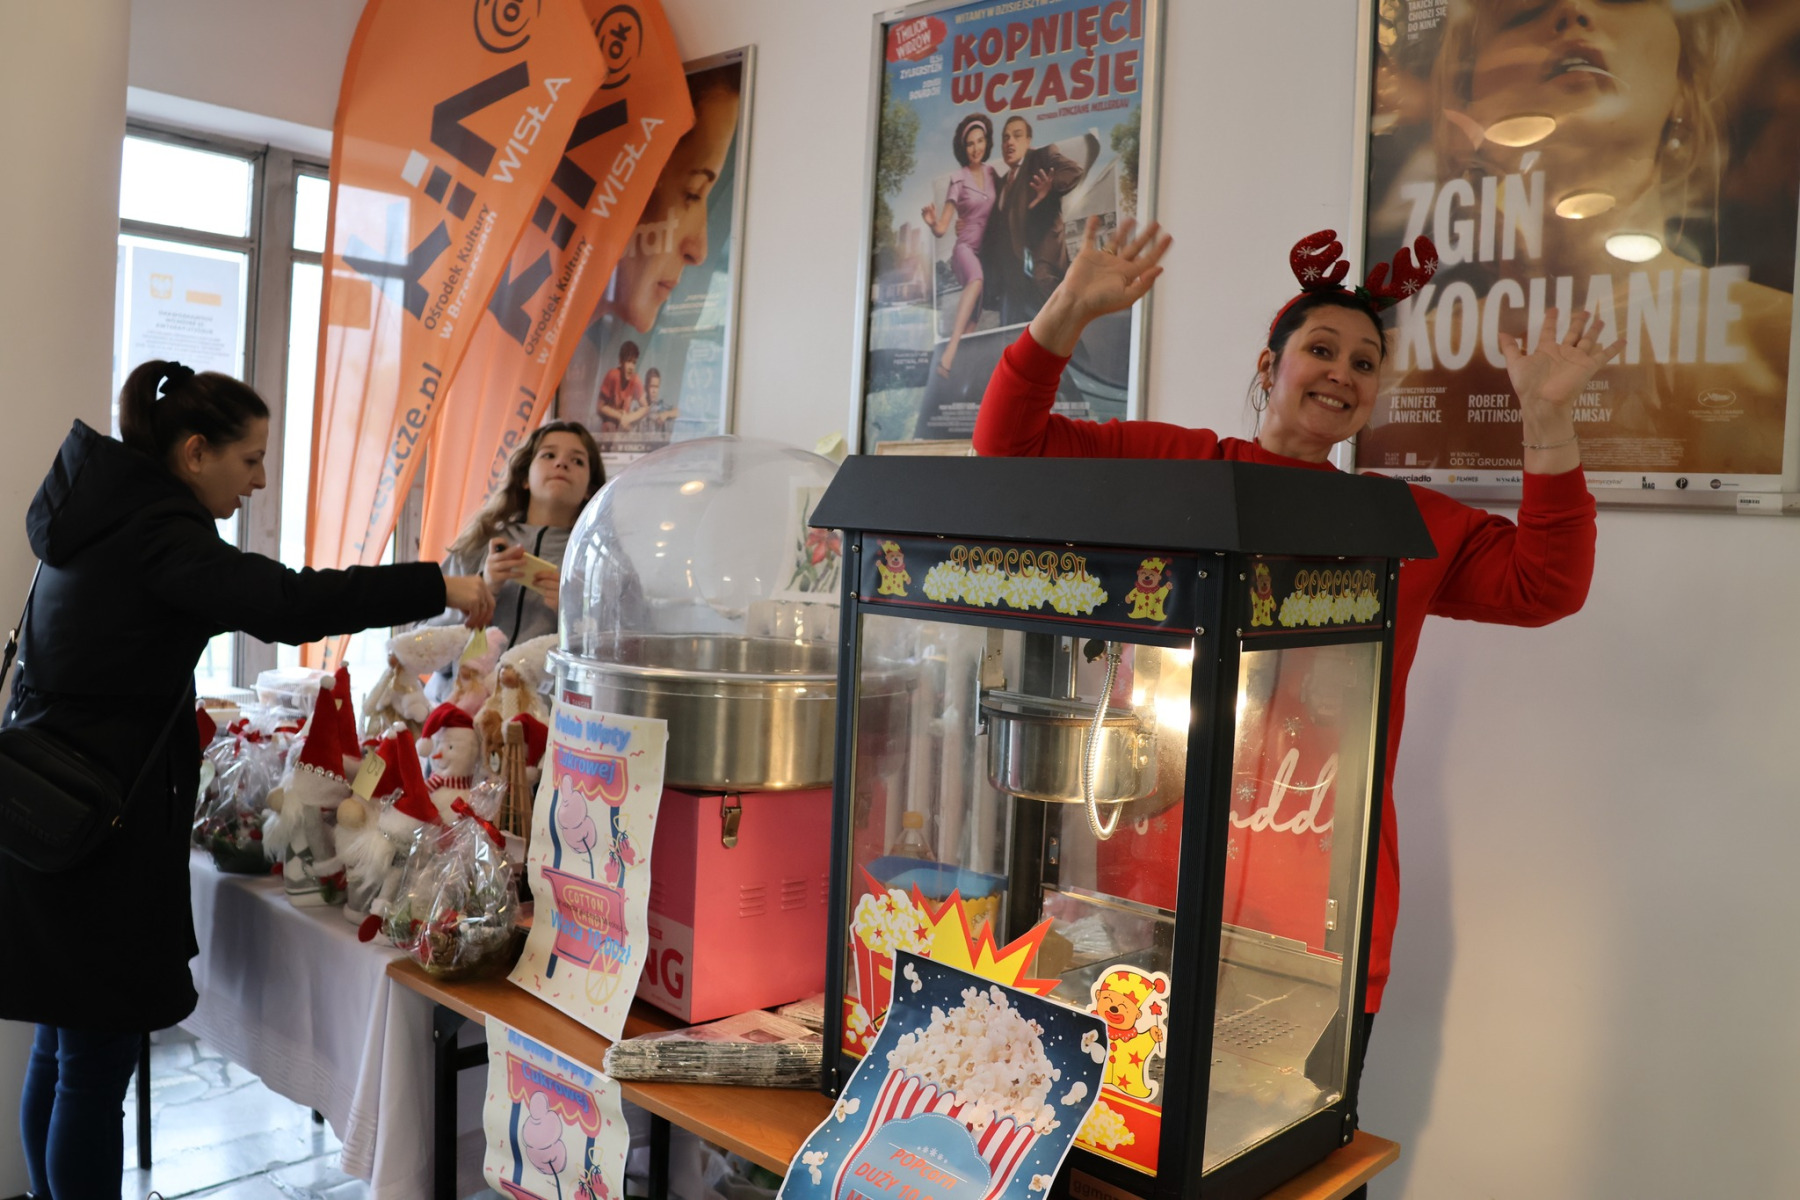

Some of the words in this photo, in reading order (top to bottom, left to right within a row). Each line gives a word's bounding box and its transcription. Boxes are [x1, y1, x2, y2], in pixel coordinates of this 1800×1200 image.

[1407, 22, 1419, 33] DO
[1408, 8, 1434, 22] CHODZI
[952, 0, 1144, 73] KOPNIĘCI
[492, 77, 572, 184] WISŁA
[591, 116, 664, 219] WISŁA
[424, 266, 464, 331] Ośrodek
[456, 203, 491, 263] Kultury
[447, 211, 498, 320] Brzeszczach
[524, 294, 562, 356] Ośrodek
[555, 235, 588, 292] Kultury
[1388, 410, 1443, 424] LAWRENCE
[1390, 395, 1437, 409] JENNIFER
[1468, 394, 1511, 408] ROBERT
[1571, 408, 1613, 423] AMSAY
[1449, 458, 1465, 466] OD
[1466, 458, 1476, 466] 12
[1477, 458, 1523, 467] GRUDNIA
[949, 544, 1088, 582] POPCORN
[1294, 568, 1379, 599] POPCORN
[557, 746, 617, 785] Cukrowej
[568, 889, 604, 913] COTTON
[551, 908, 583, 941] Wata
[521, 1060, 590, 1113] Cukrowej
[854, 1161, 900, 1192] DUŻY
[889, 1147, 959, 1190] POPcorn
